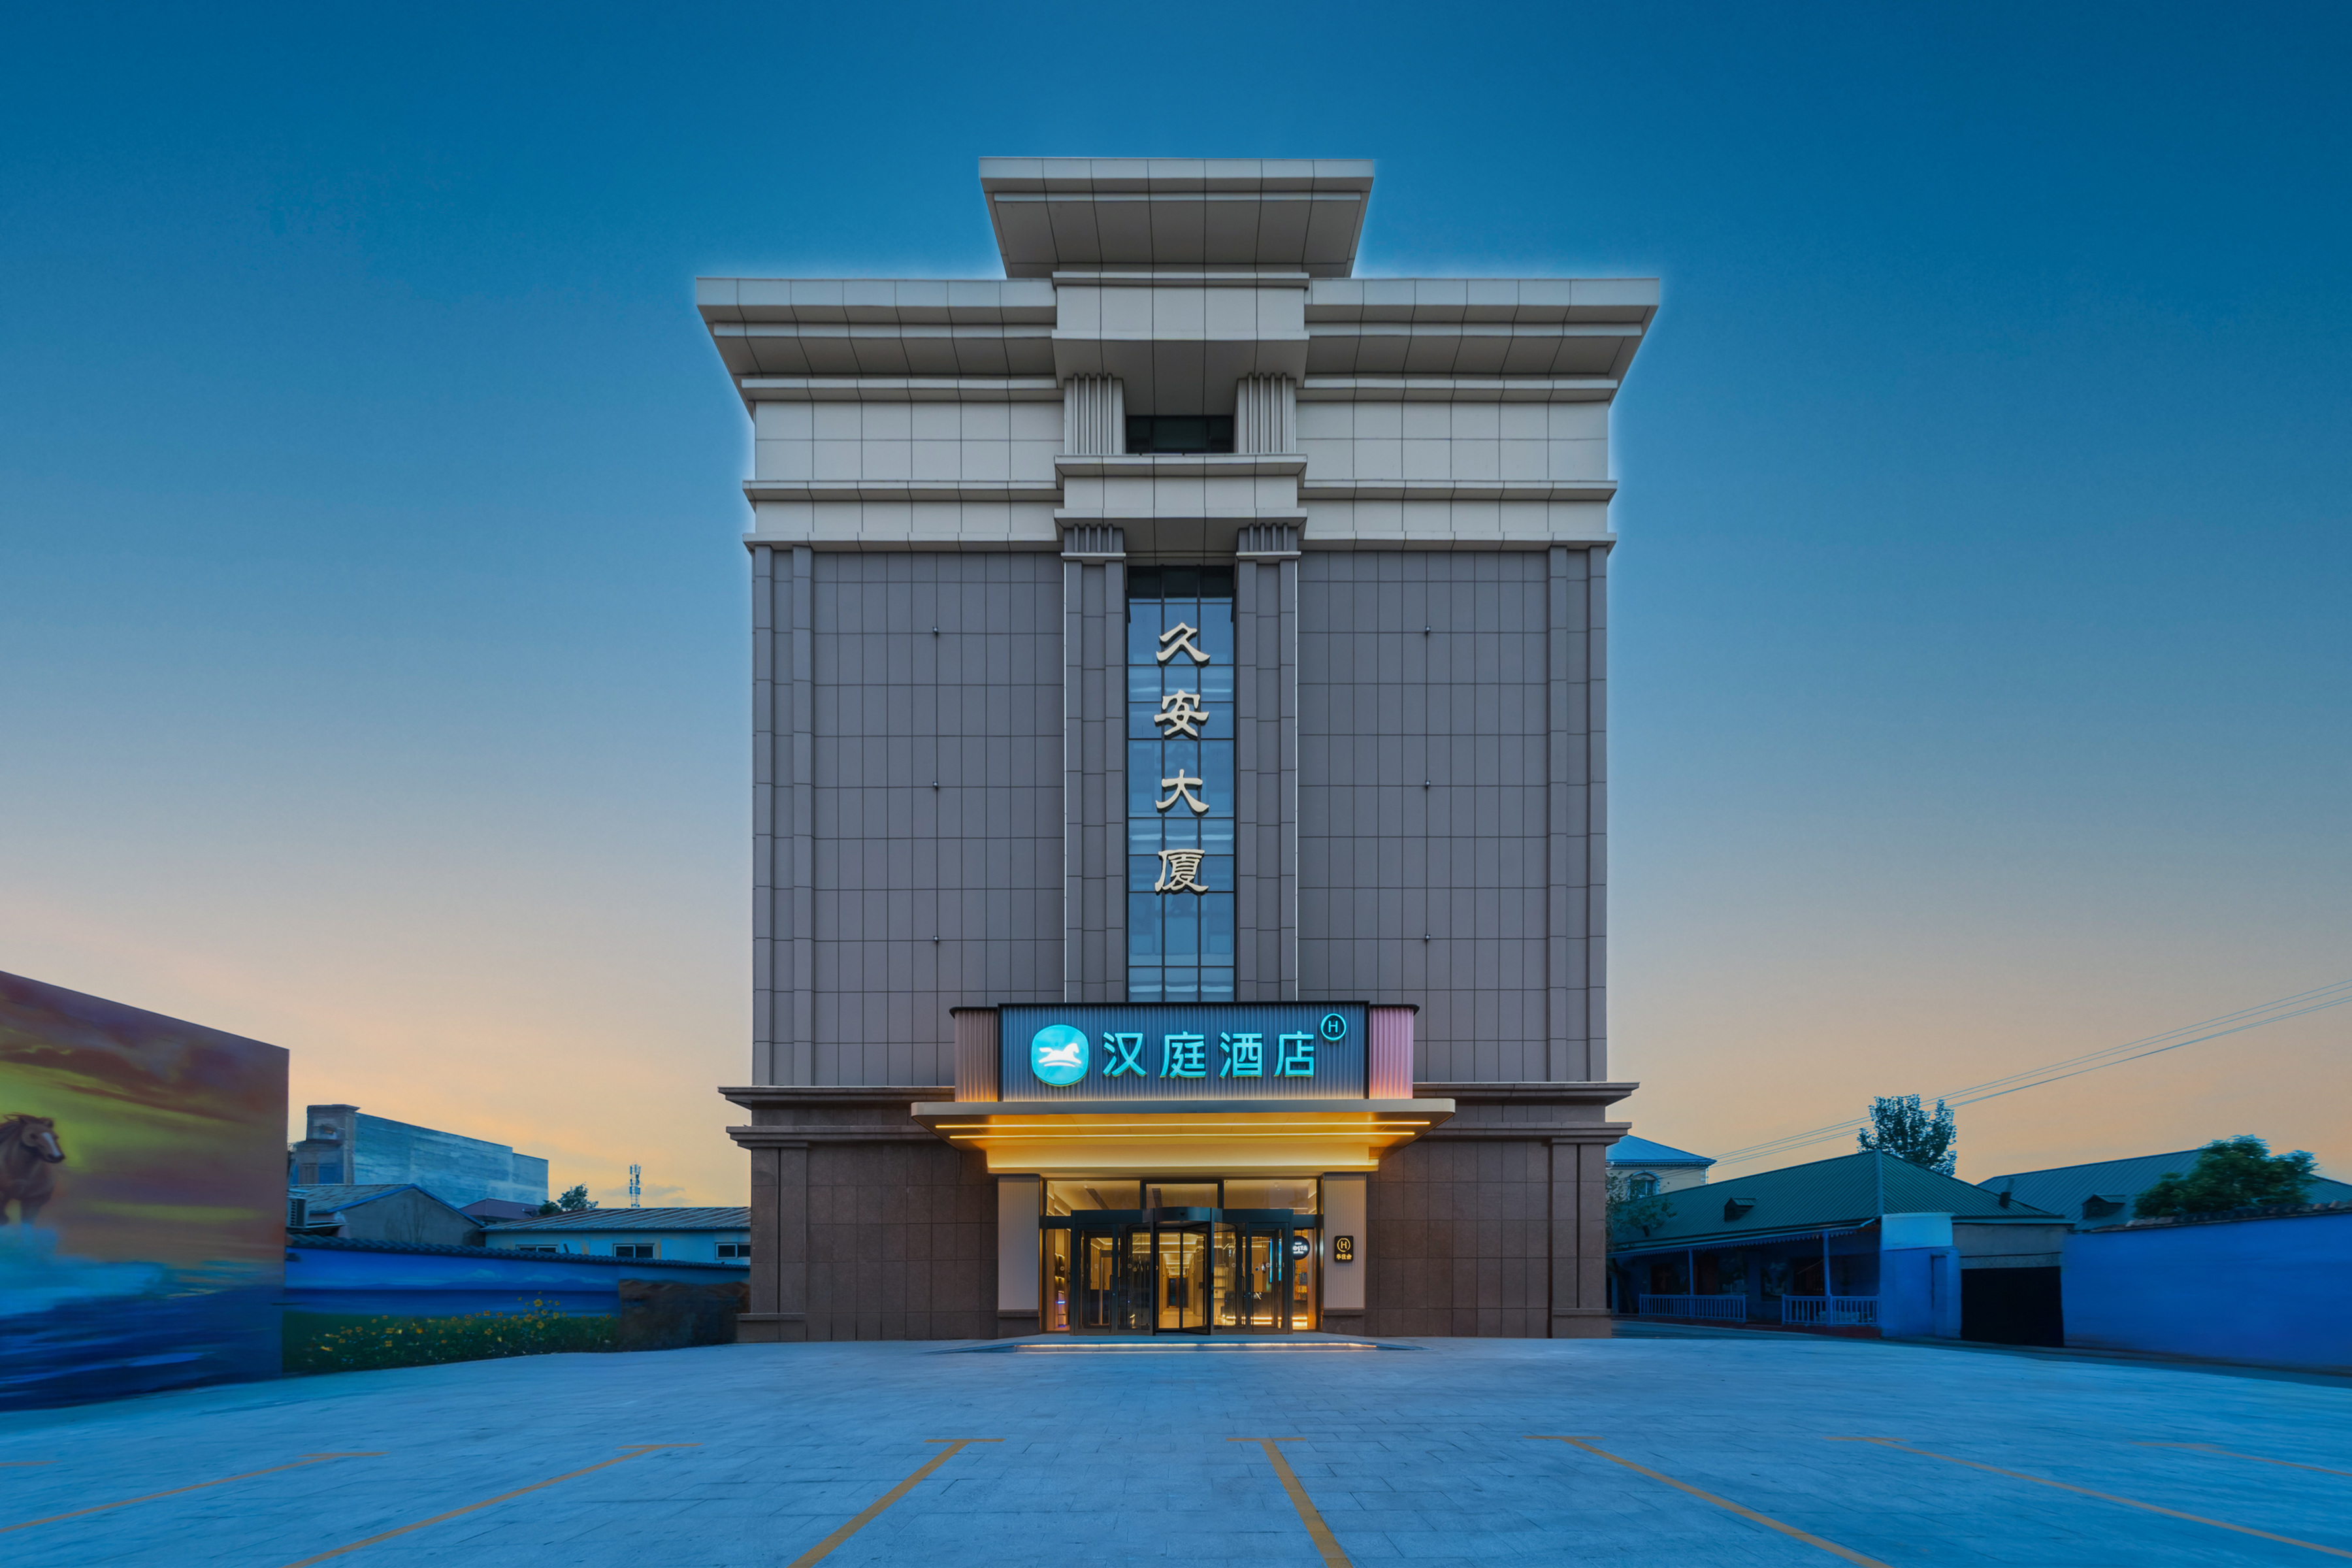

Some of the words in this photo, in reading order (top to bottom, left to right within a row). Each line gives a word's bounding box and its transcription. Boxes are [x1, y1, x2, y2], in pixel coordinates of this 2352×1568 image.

[1154, 622, 1211, 894] 久安大厦
[1103, 1030, 1315, 1078] 汉庭酒店
